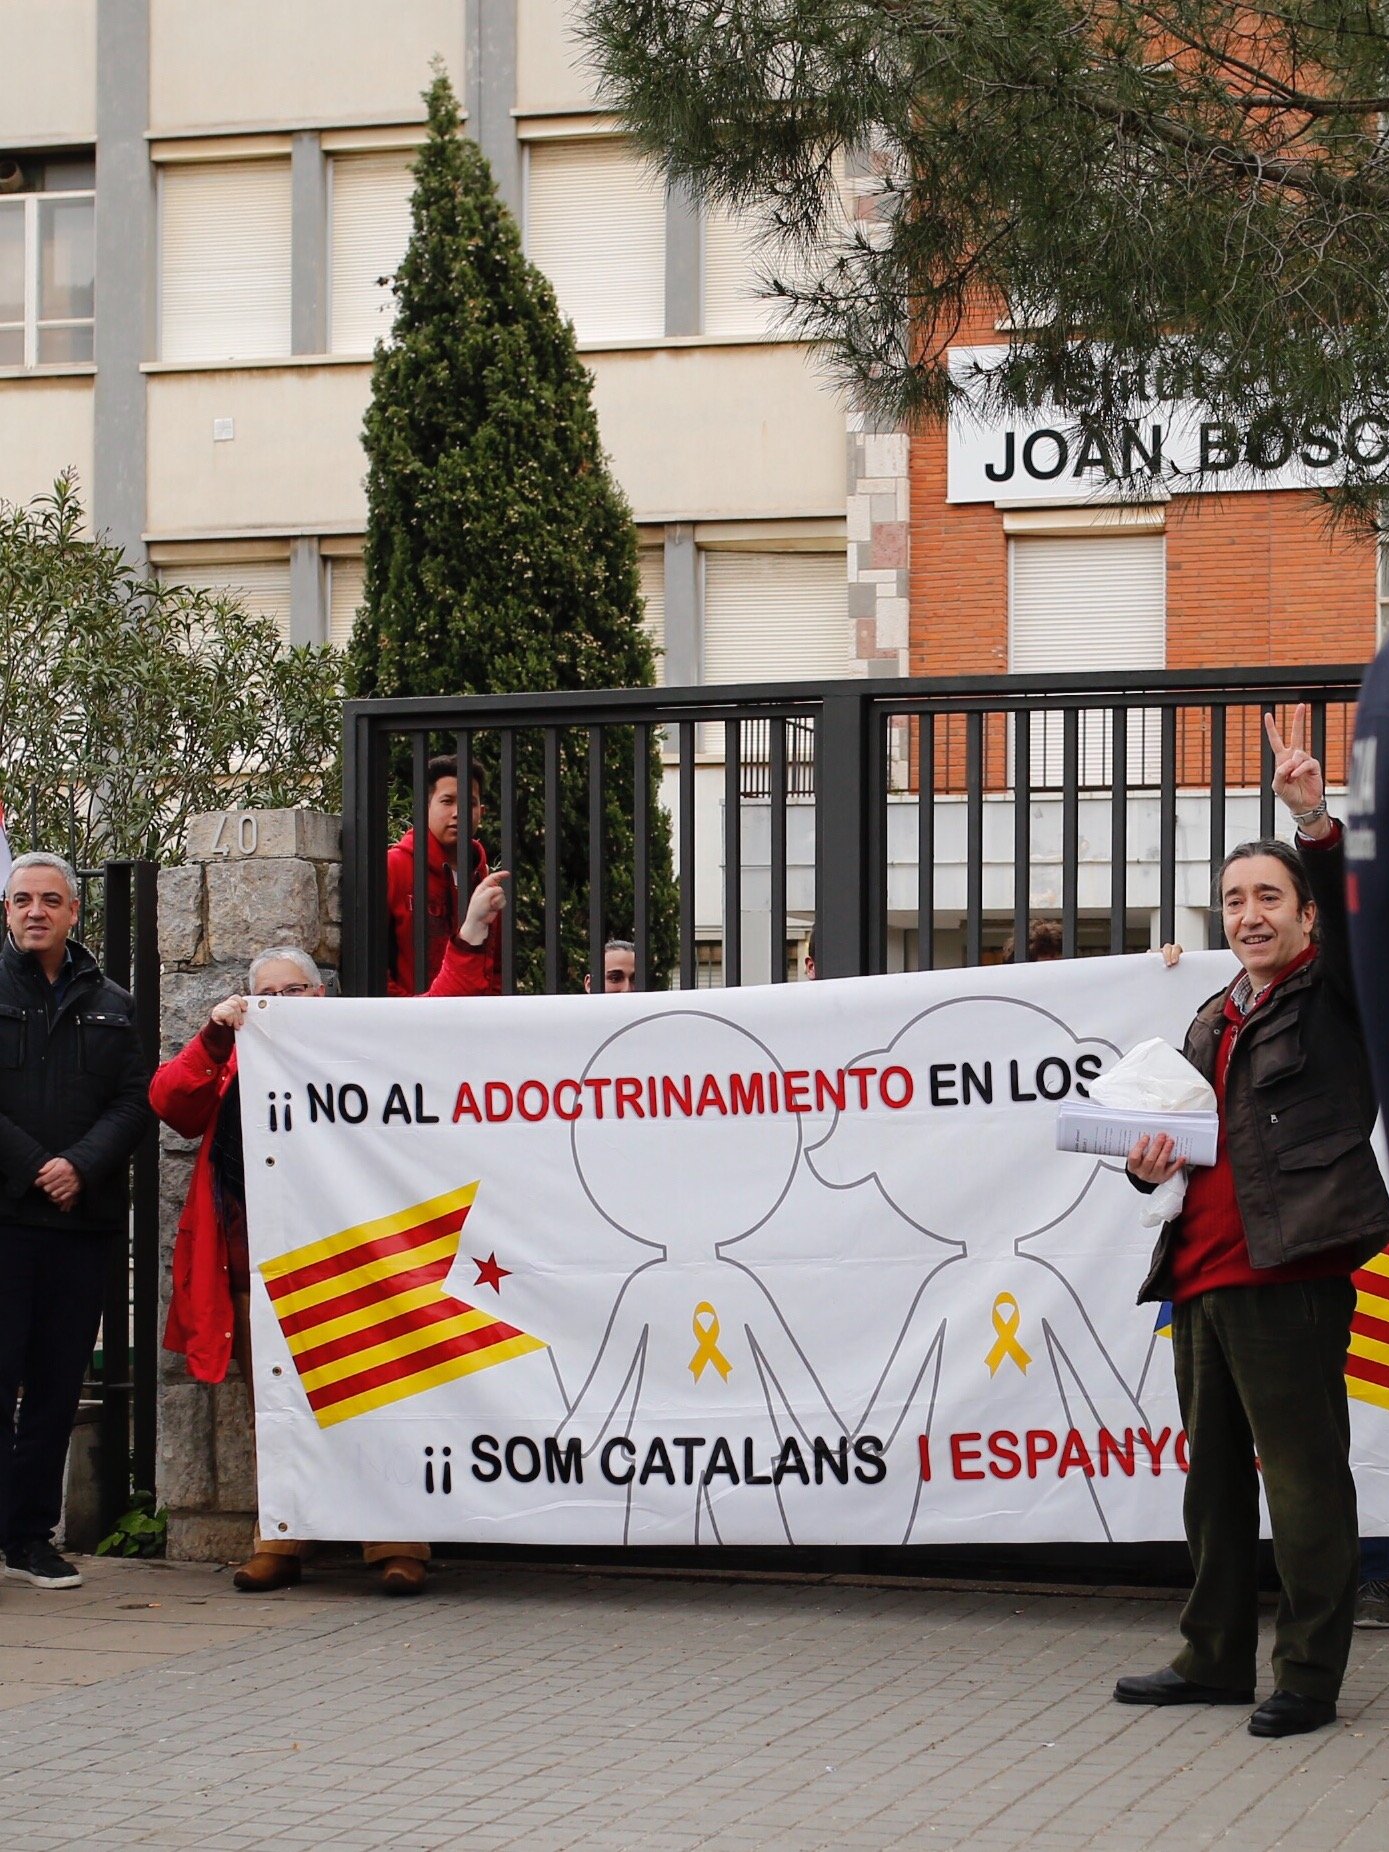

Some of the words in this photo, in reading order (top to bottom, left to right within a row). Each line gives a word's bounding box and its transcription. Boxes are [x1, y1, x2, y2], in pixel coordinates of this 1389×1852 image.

[985, 424, 1162, 482] JOAN
[211, 814, 258, 857] 40
[307, 1083, 369, 1124] NO
[382, 1083, 440, 1124] AL
[453, 1066, 914, 1123] ADOCTRINAMIENTO
[929, 1062, 993, 1107] EN
[1010, 1055, 1103, 1102] LOS
[471, 1435, 584, 1485] SOM
[600, 1435, 887, 1488] CATALANS
[918, 1433, 931, 1481] I
